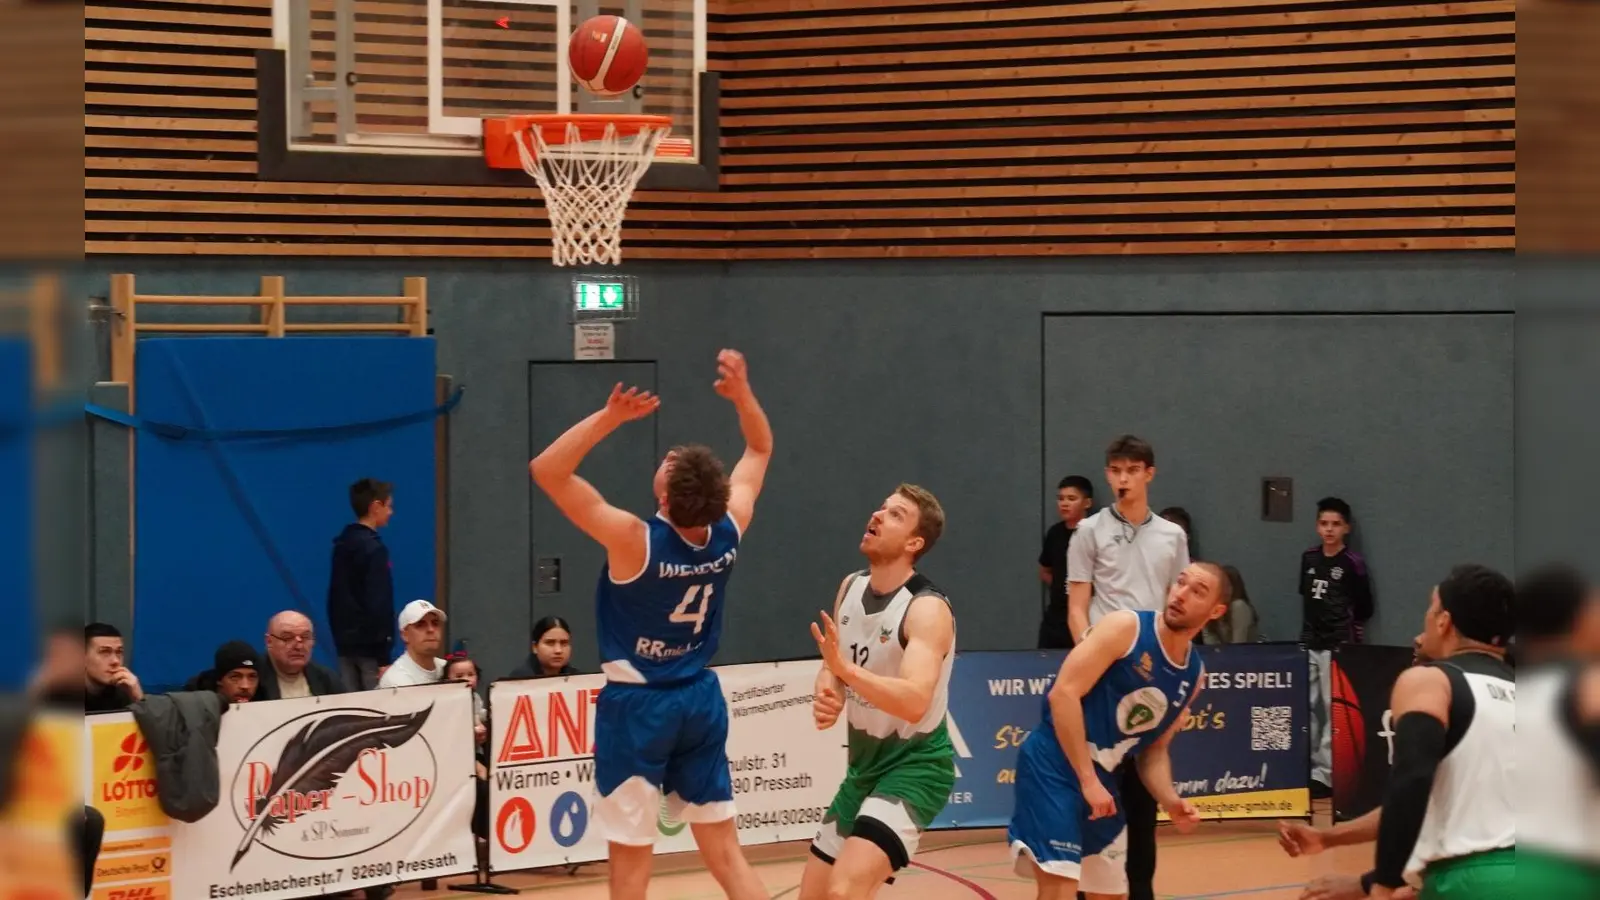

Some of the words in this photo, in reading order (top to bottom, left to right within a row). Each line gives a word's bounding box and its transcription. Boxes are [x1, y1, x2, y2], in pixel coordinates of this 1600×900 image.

[1311, 579, 1329, 599] T
[669, 583, 714, 634] 4
[850, 643, 869, 667] 12
[988, 679, 1024, 696] WIR
[1234, 671, 1292, 688] SPIEL!
[1173, 681, 1190, 707] 5
[772, 752, 786, 769] 31
[496, 770, 560, 791] Wärme
[754, 773, 812, 792] Pressath
[1214, 762, 1268, 793] dazu!
[102, 778, 158, 802] LOTTO
[352, 865, 392, 880] 92690
[397, 853, 458, 874] Pressath
